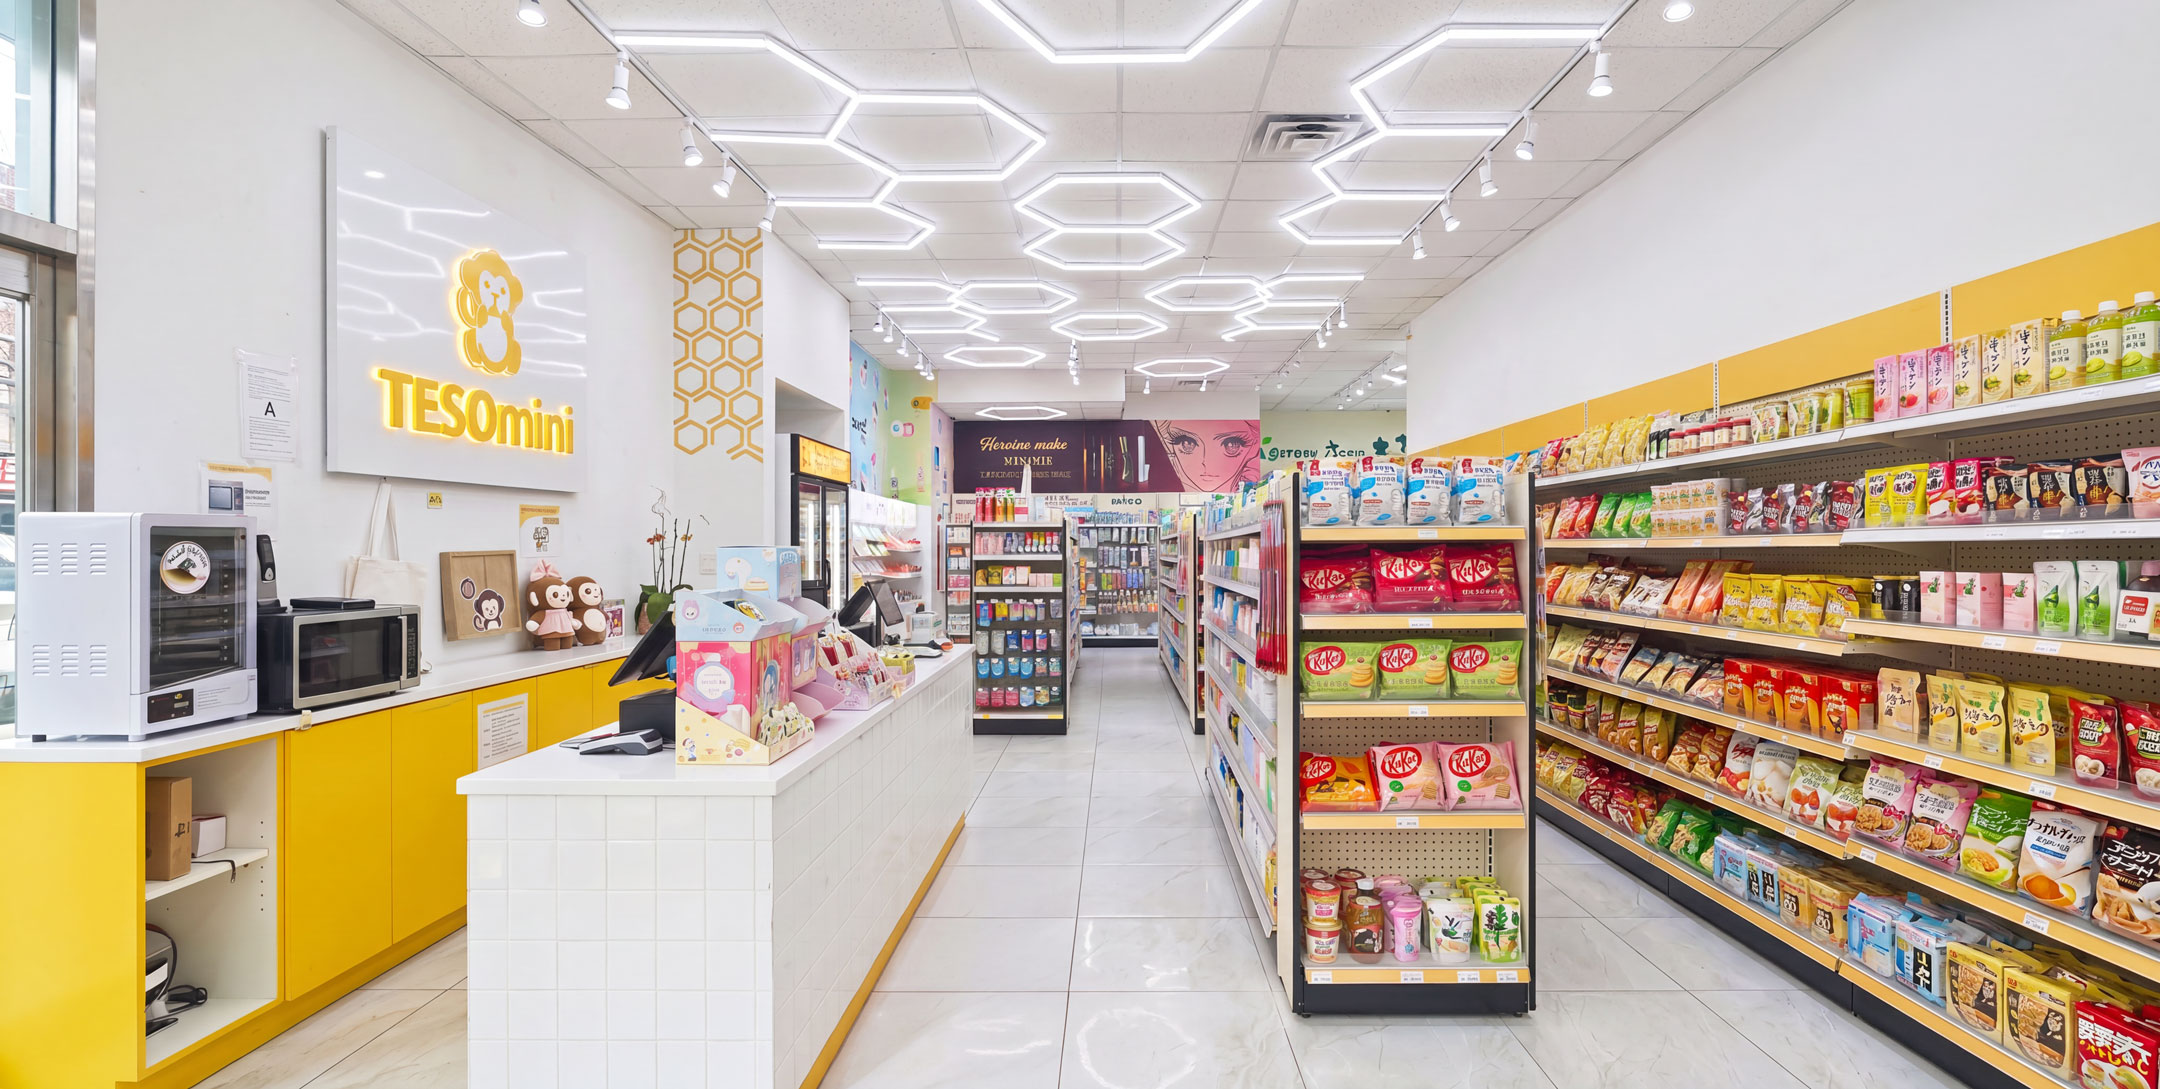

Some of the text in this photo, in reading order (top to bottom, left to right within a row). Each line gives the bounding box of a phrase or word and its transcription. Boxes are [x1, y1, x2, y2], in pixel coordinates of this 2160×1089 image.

[264, 401, 276, 417] A
[378, 368, 574, 454] TESOmini
[979, 436, 1068, 452] Heroine make
